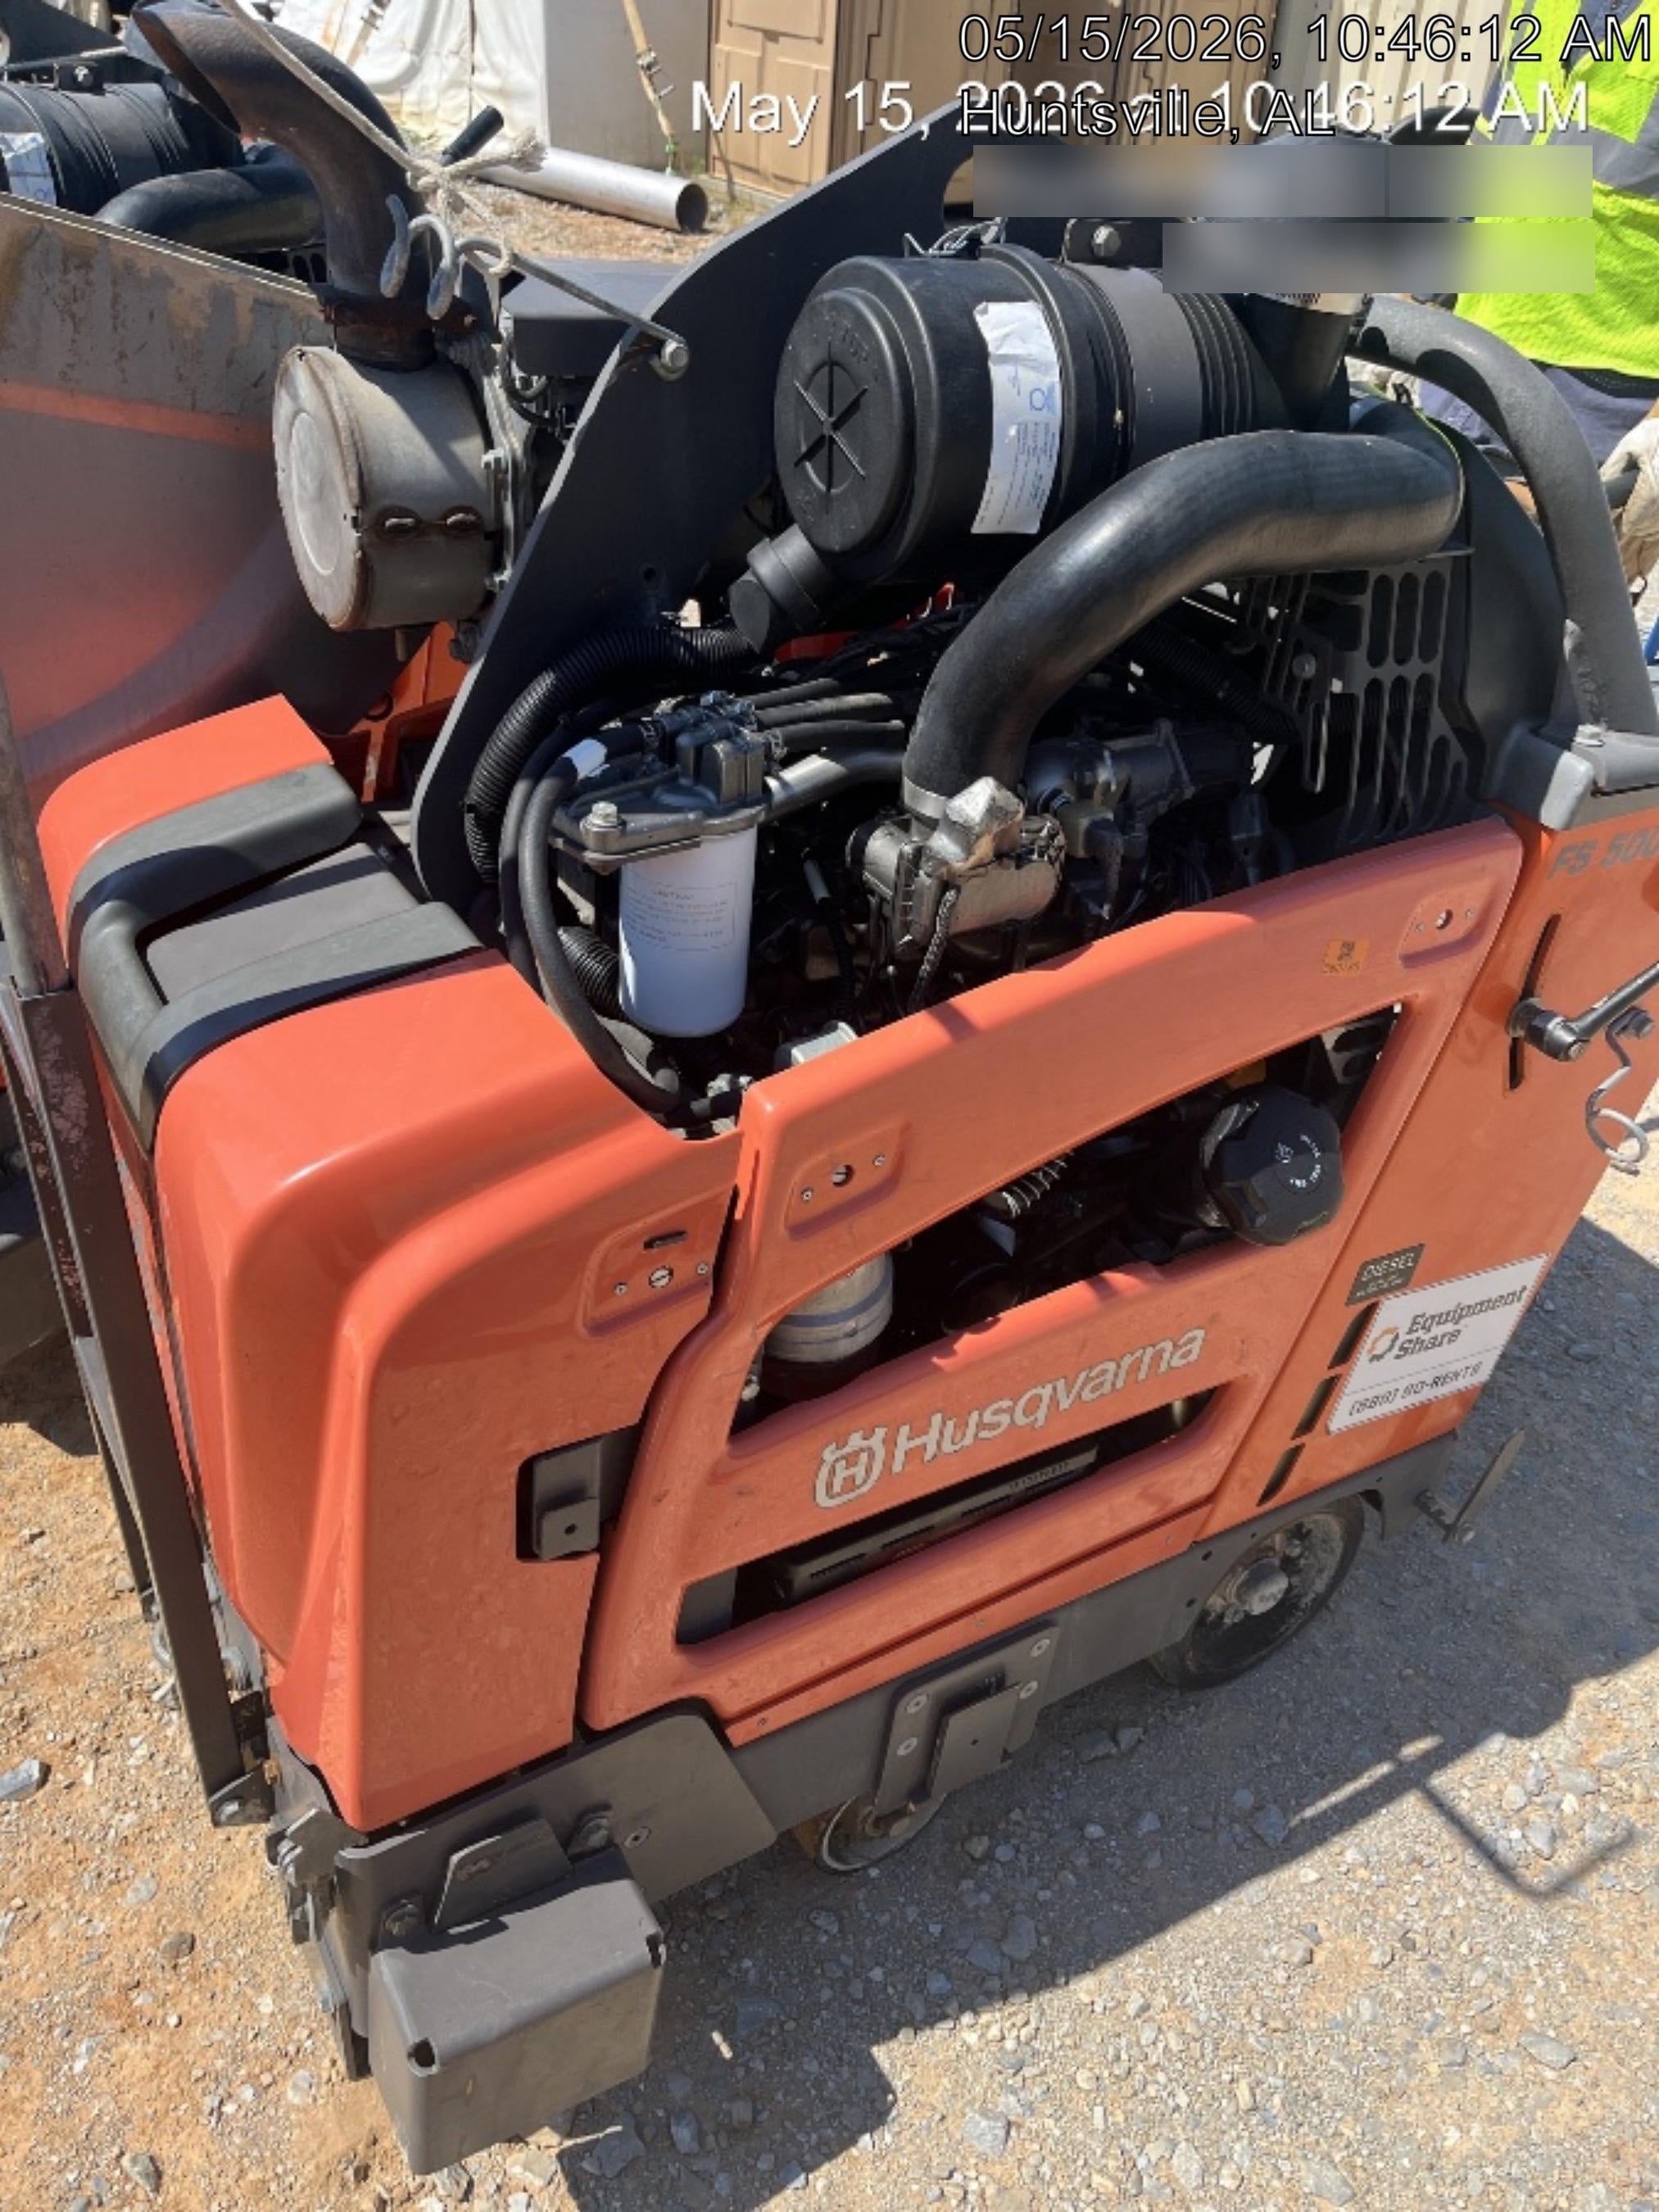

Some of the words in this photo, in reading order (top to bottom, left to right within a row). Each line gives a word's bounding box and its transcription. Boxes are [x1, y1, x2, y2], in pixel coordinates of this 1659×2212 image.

[1362, 1253, 1414, 1281] DIESEL
[1406, 1285, 1528, 1335] Equipment
[1394, 1328, 1462, 1361] Share
[893, 1327, 1206, 1475] Husqvarna
